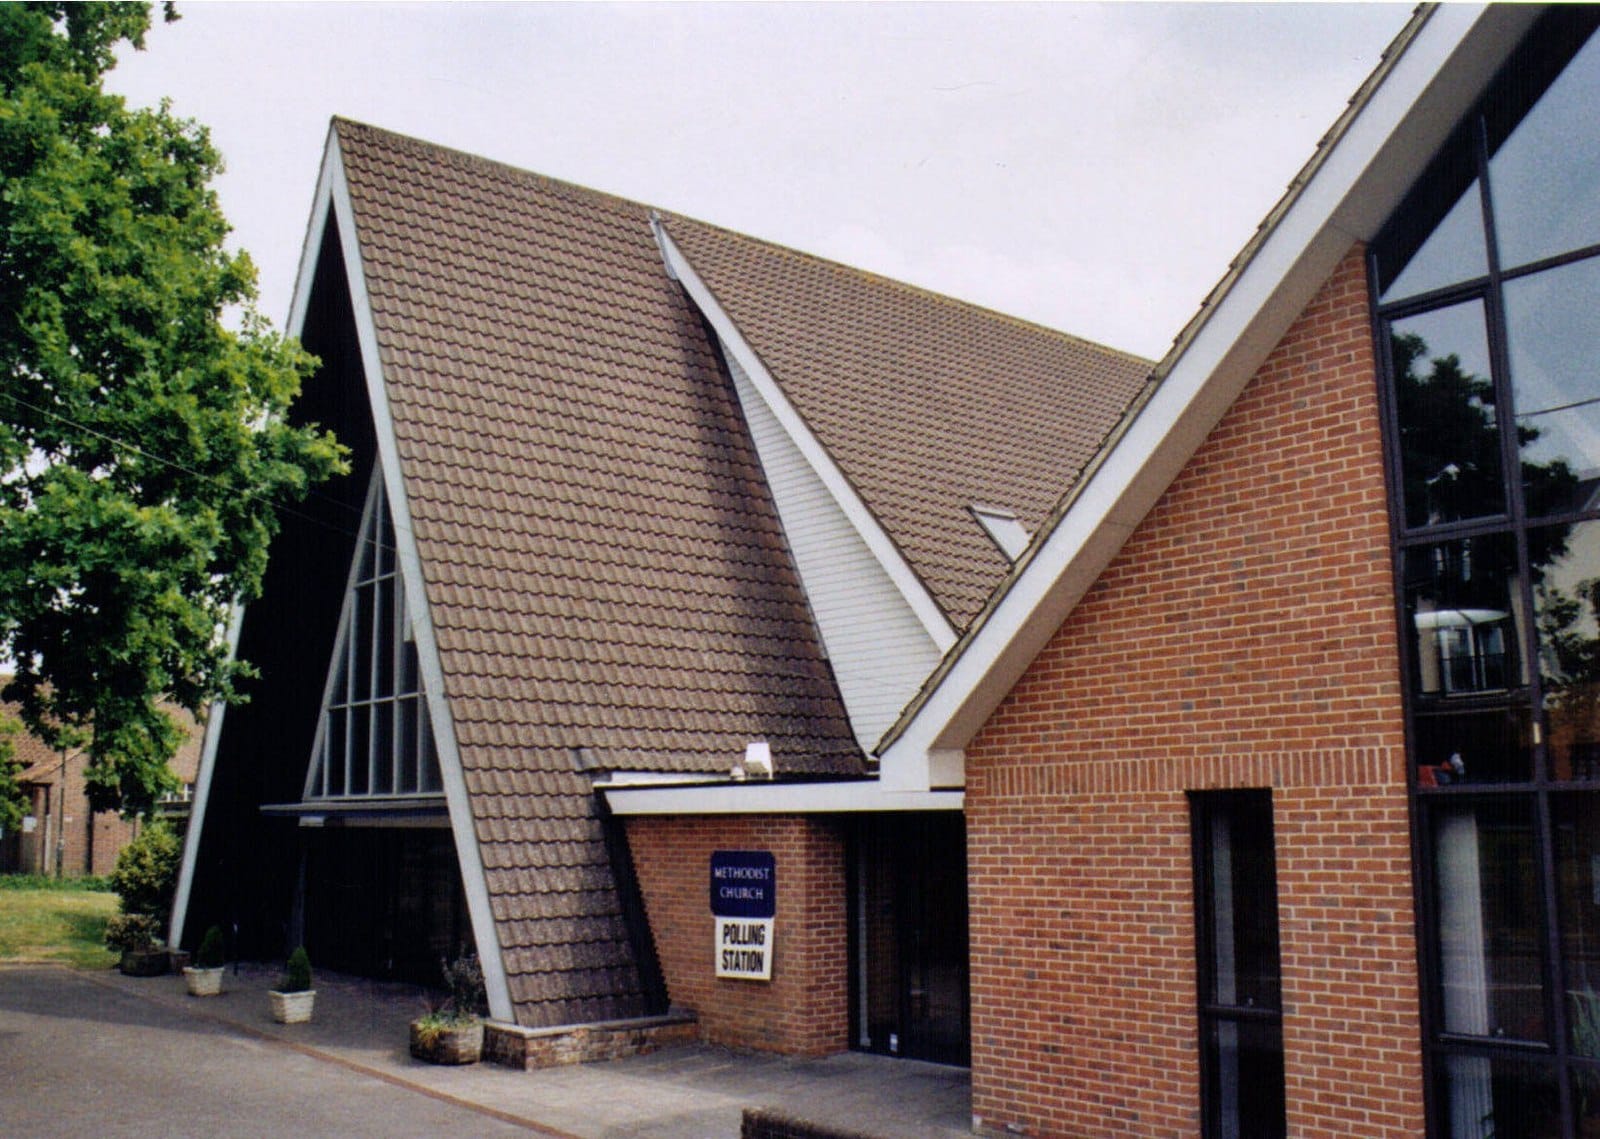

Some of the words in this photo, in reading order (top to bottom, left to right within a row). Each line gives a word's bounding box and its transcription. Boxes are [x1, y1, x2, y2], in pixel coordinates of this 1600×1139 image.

[714, 867, 770, 880] METHODIST
[719, 887, 764, 900] CHURCH
[723, 923, 765, 945] POLLING
[722, 949, 764, 972] STATION
